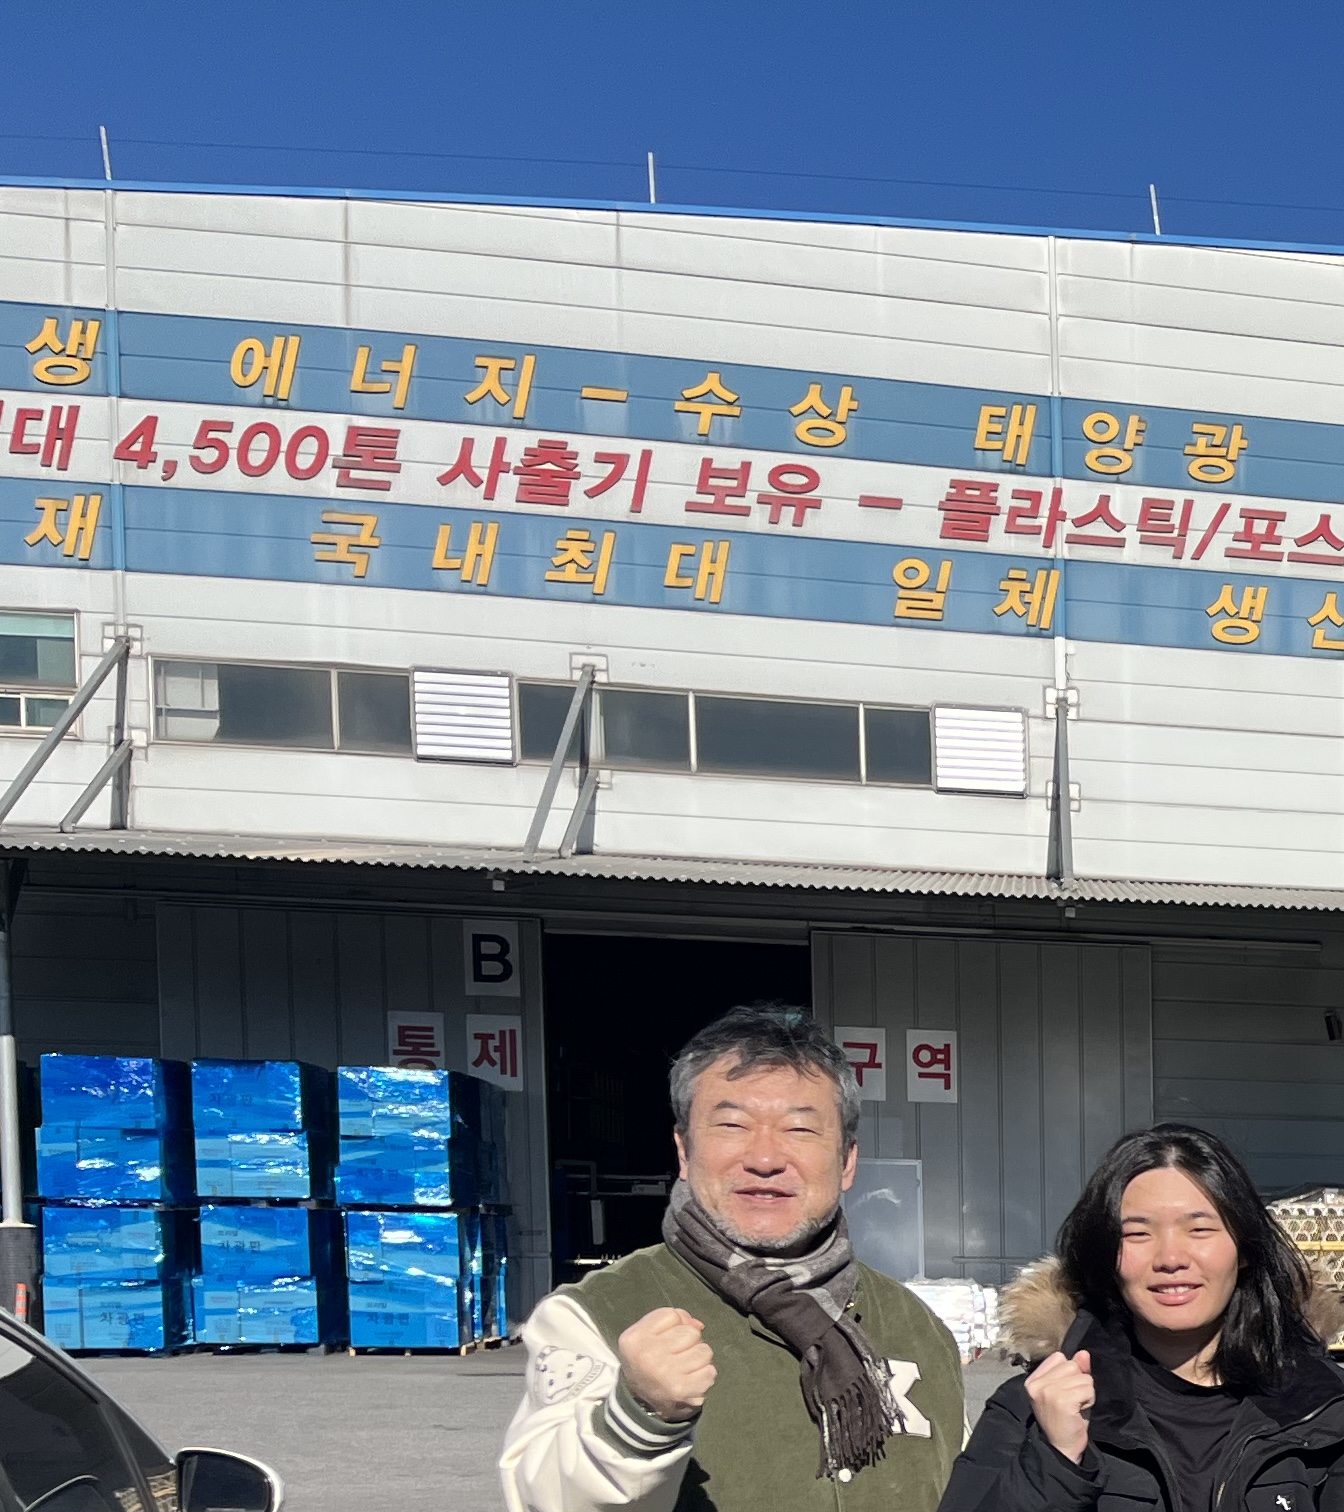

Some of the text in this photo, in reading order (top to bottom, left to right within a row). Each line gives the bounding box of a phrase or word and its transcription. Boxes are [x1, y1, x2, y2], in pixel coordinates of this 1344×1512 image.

[0, 399, 81, 471] 대
[113, 414, 402, 491] 4,500톤
[437, 435, 654, 513] 사출기
[685, 457, 822, 527] 보유
[26, 318, 102, 385] 생
[974, 403, 1249, 485] 태양광
[24, 493, 103, 561] 재
[310, 510, 731, 604] 국내최대
[892, 557, 1061, 631] 일체
[471, 933, 513, 983] B
